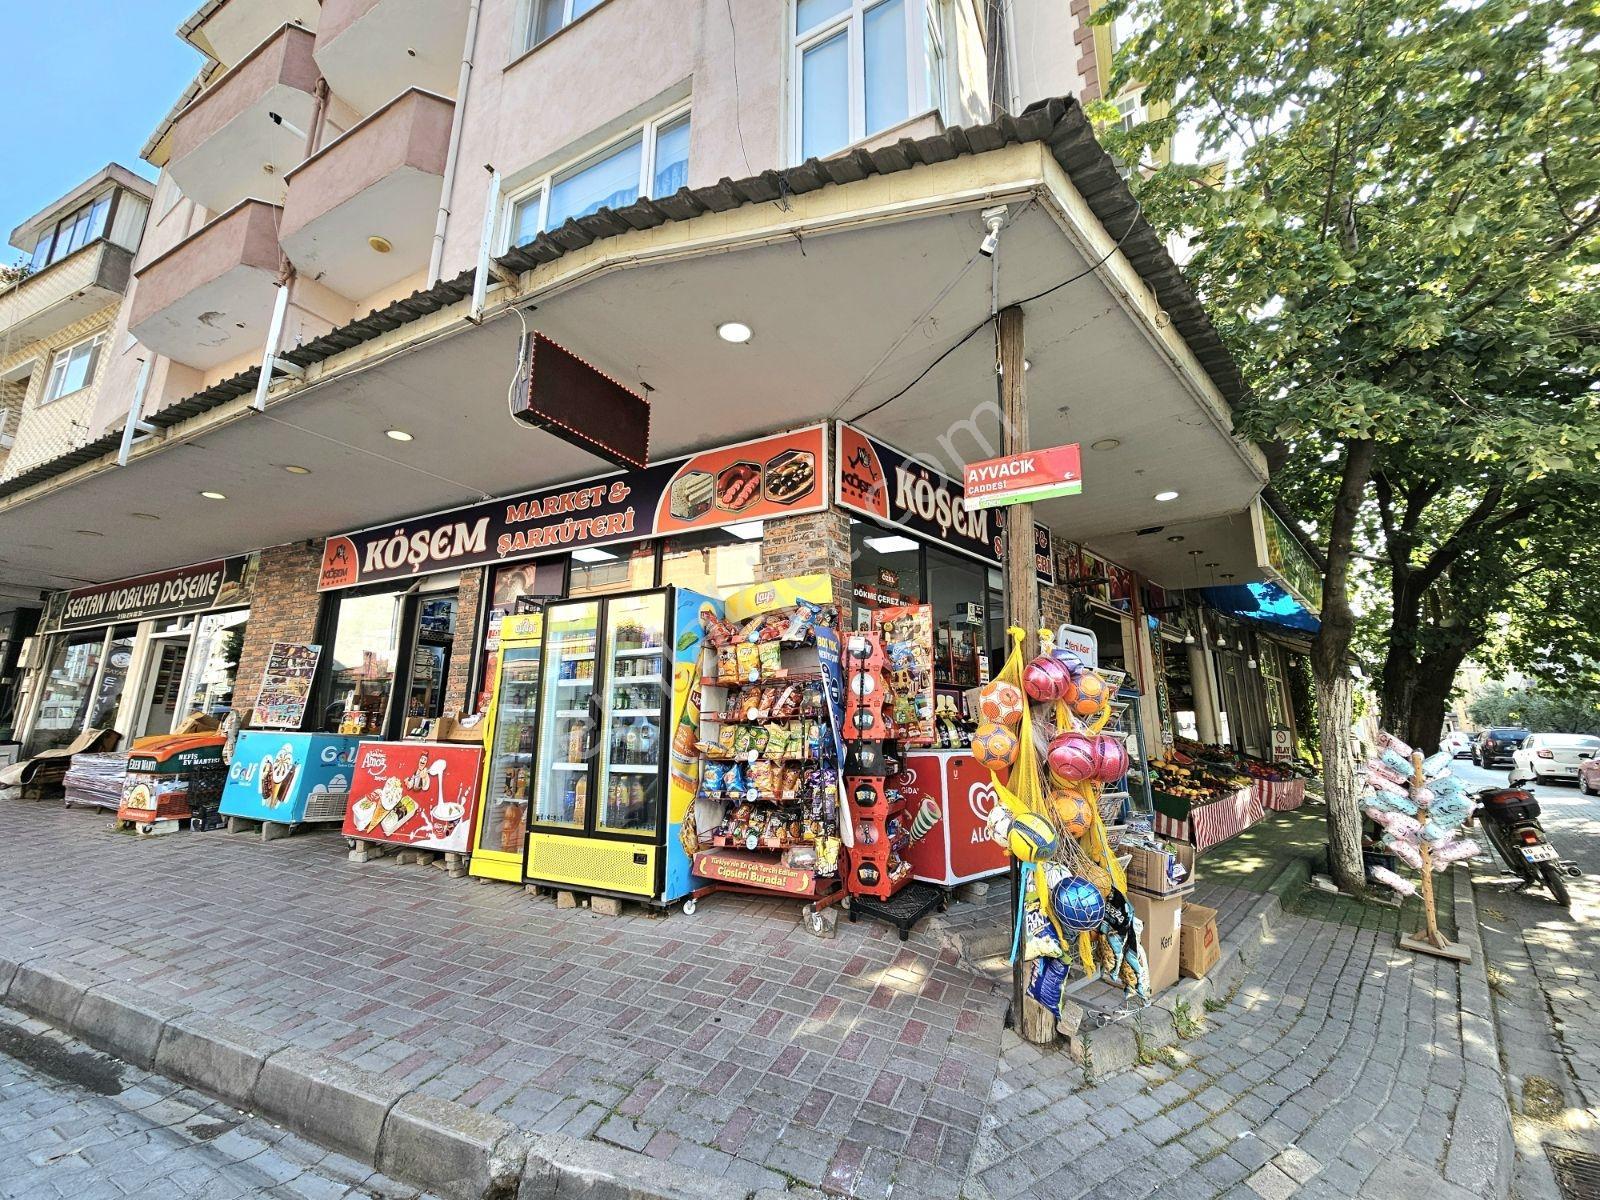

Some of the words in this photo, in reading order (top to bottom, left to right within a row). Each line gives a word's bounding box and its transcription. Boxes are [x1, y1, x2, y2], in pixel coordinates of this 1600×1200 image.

[505, 485, 606, 524] MARKET
[607, 481, 631, 504] &
[894, 466, 990, 545] KÖŞEM
[362, 516, 491, 573] KÖŞEM
[496, 506, 636, 558] ŞARKÜTERİ
[64, 593, 107, 619] SERTAN
[160, 571, 219, 608] DÖŞEME
[853, 588, 877, 601] DÖKME
[877, 594, 899, 606] ÇEREZ
[717, 866, 749, 880] Cipsleri
[750, 872, 787, 887] Burada!
[740, 860, 747, 868] En
[747, 862, 759, 872] Çok
